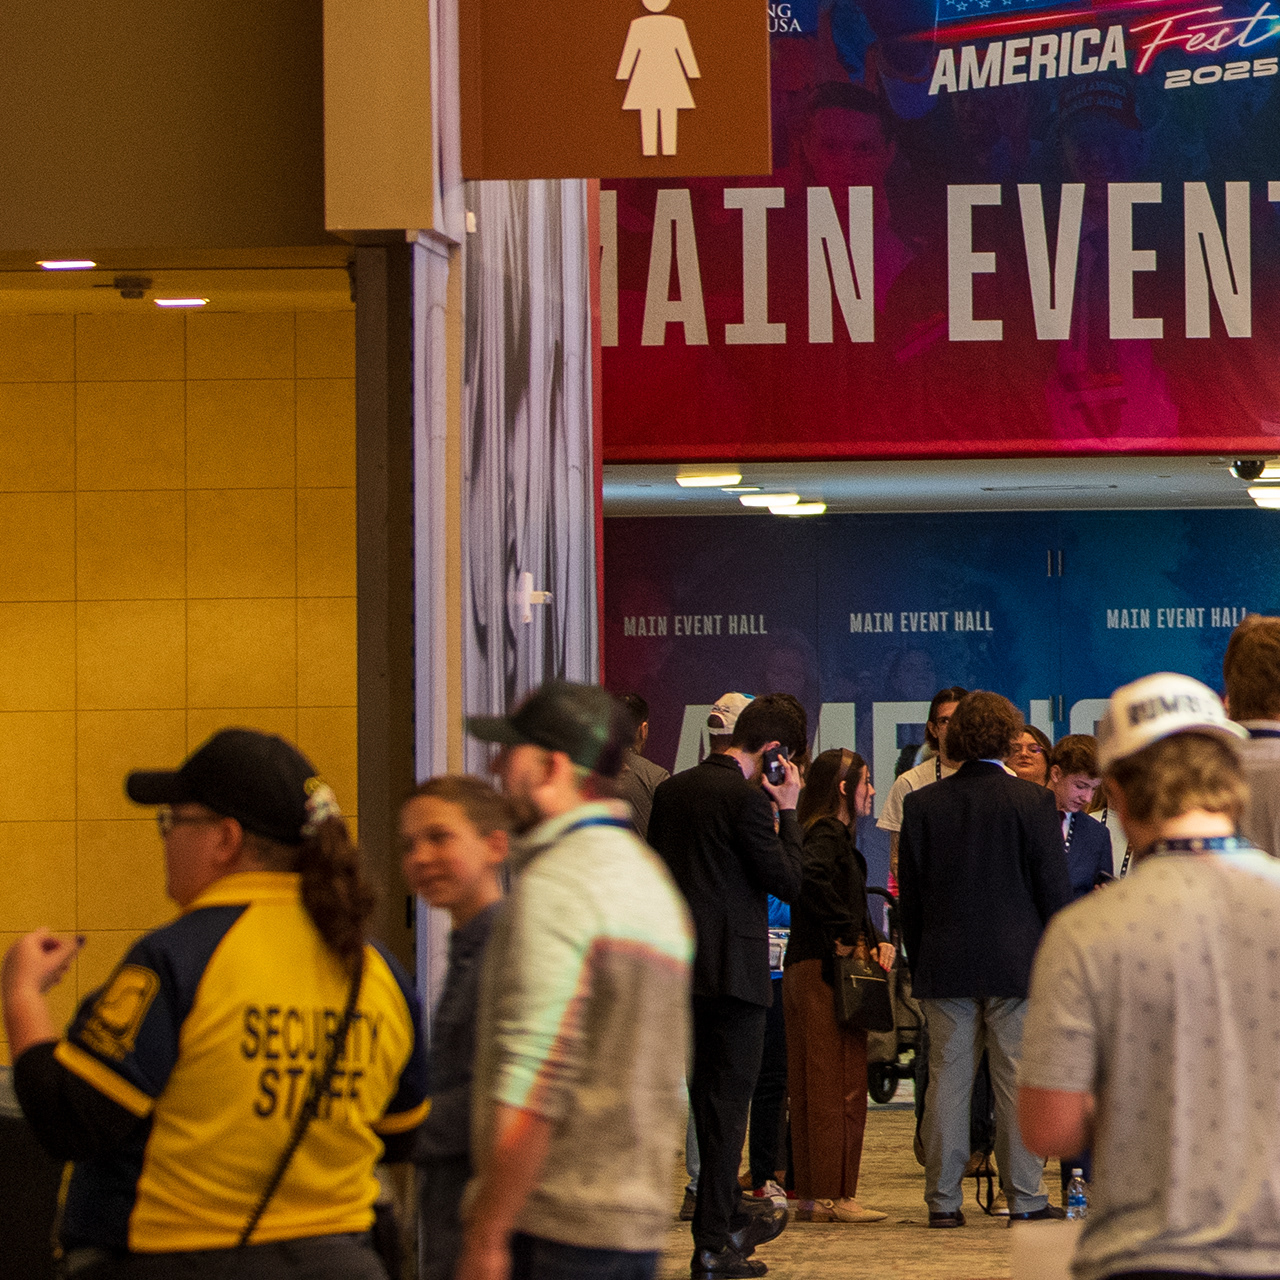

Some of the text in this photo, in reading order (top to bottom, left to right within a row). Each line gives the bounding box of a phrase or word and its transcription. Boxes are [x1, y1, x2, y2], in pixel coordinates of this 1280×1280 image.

[768, 17, 803, 33] USA
[927, 24, 1127, 96] AMERICA
[1164, 56, 1279, 90] 2025
[600, 186, 875, 348] AIN
[624, 614, 768, 637] MAIN EVENT HALL
[849, 611, 993, 633] MAIN EVENT HALL
[1106, 608, 1150, 629] MAIN
[1157, 608, 1205, 629] EVENT
[240, 1005, 384, 1063] SECURITY
[253, 1068, 365, 1121] STAFF
